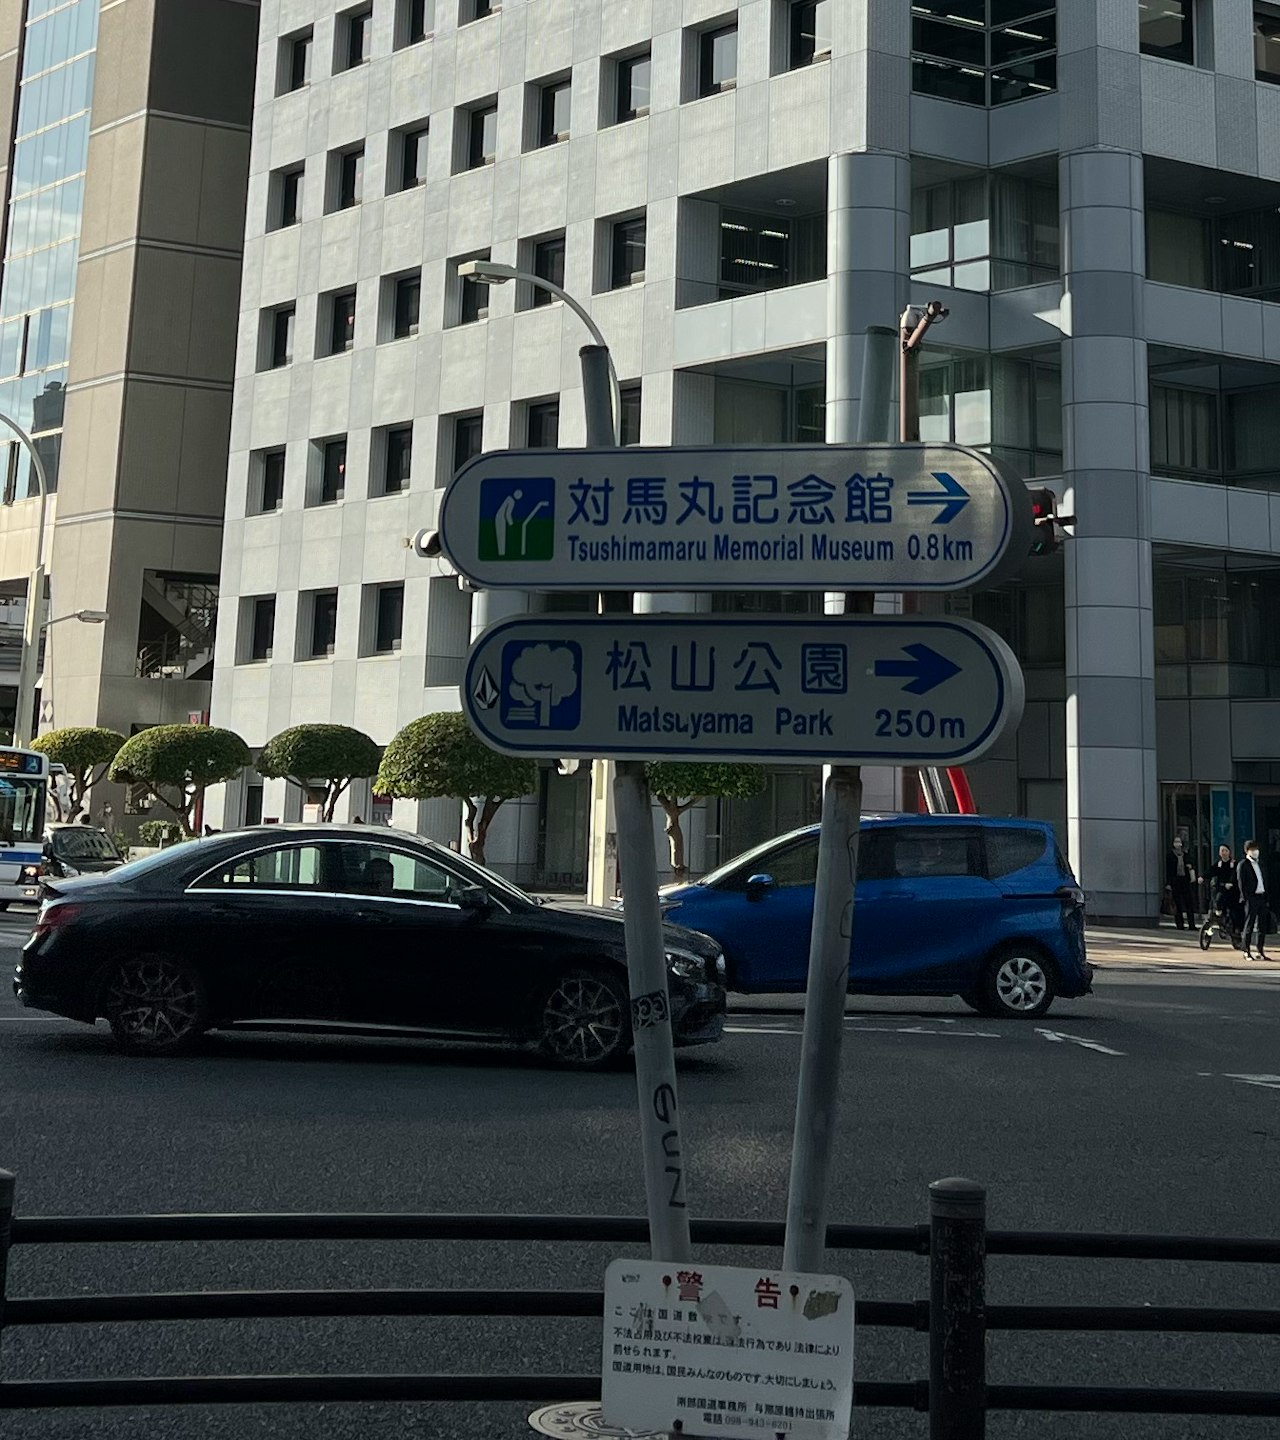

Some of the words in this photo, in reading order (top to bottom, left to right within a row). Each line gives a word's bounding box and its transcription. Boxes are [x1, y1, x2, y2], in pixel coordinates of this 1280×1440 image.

[567, 472, 895, 526] 対馬丸記念館
[567, 534, 708, 562] Tsushimamaru
[714, 534, 805, 562] Memorial
[811, 535, 894, 562] Museum
[604, 640, 848, 695] 松山公園
[617, 705, 753, 740] Matsuyama
[775, 708, 833, 736] Park
[874, 709, 965, 738] 250m
